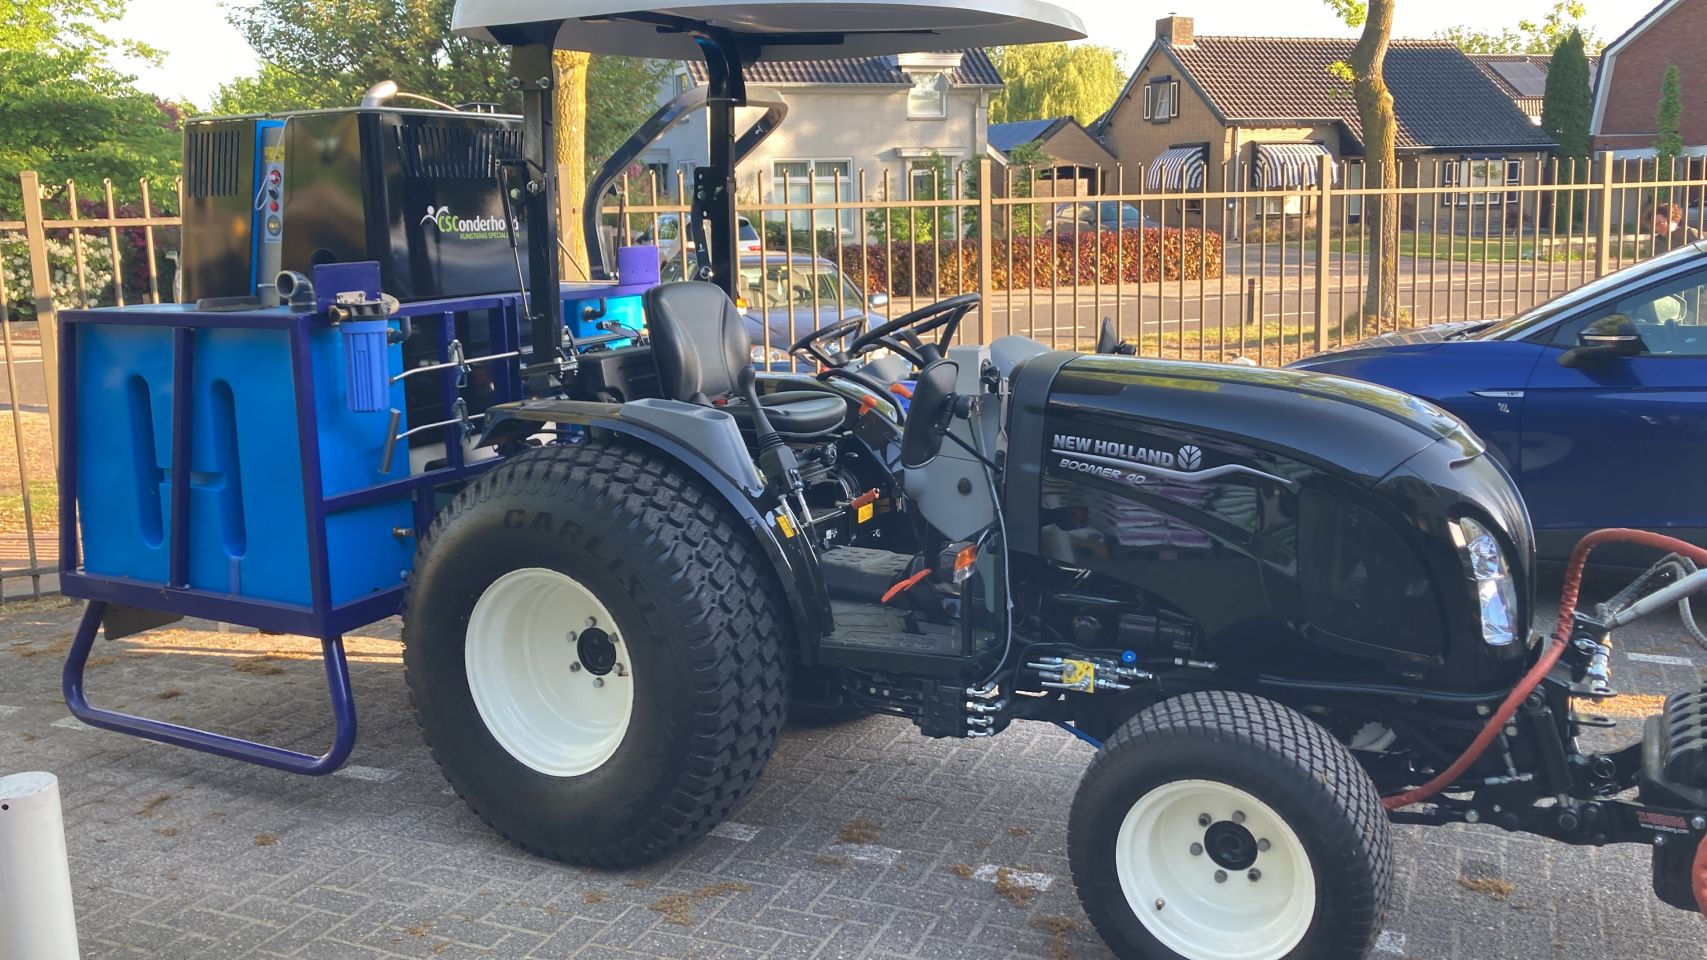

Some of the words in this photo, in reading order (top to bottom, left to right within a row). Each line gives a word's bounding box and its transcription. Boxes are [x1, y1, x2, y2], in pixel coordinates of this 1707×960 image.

[438, 215, 519, 232] CSConderhod
[1053, 434, 1092, 451] NEW
[1094, 439, 1174, 466] HOLLAND
[1059, 458, 1122, 479] BOOMER
[1126, 473, 1146, 485] 40
